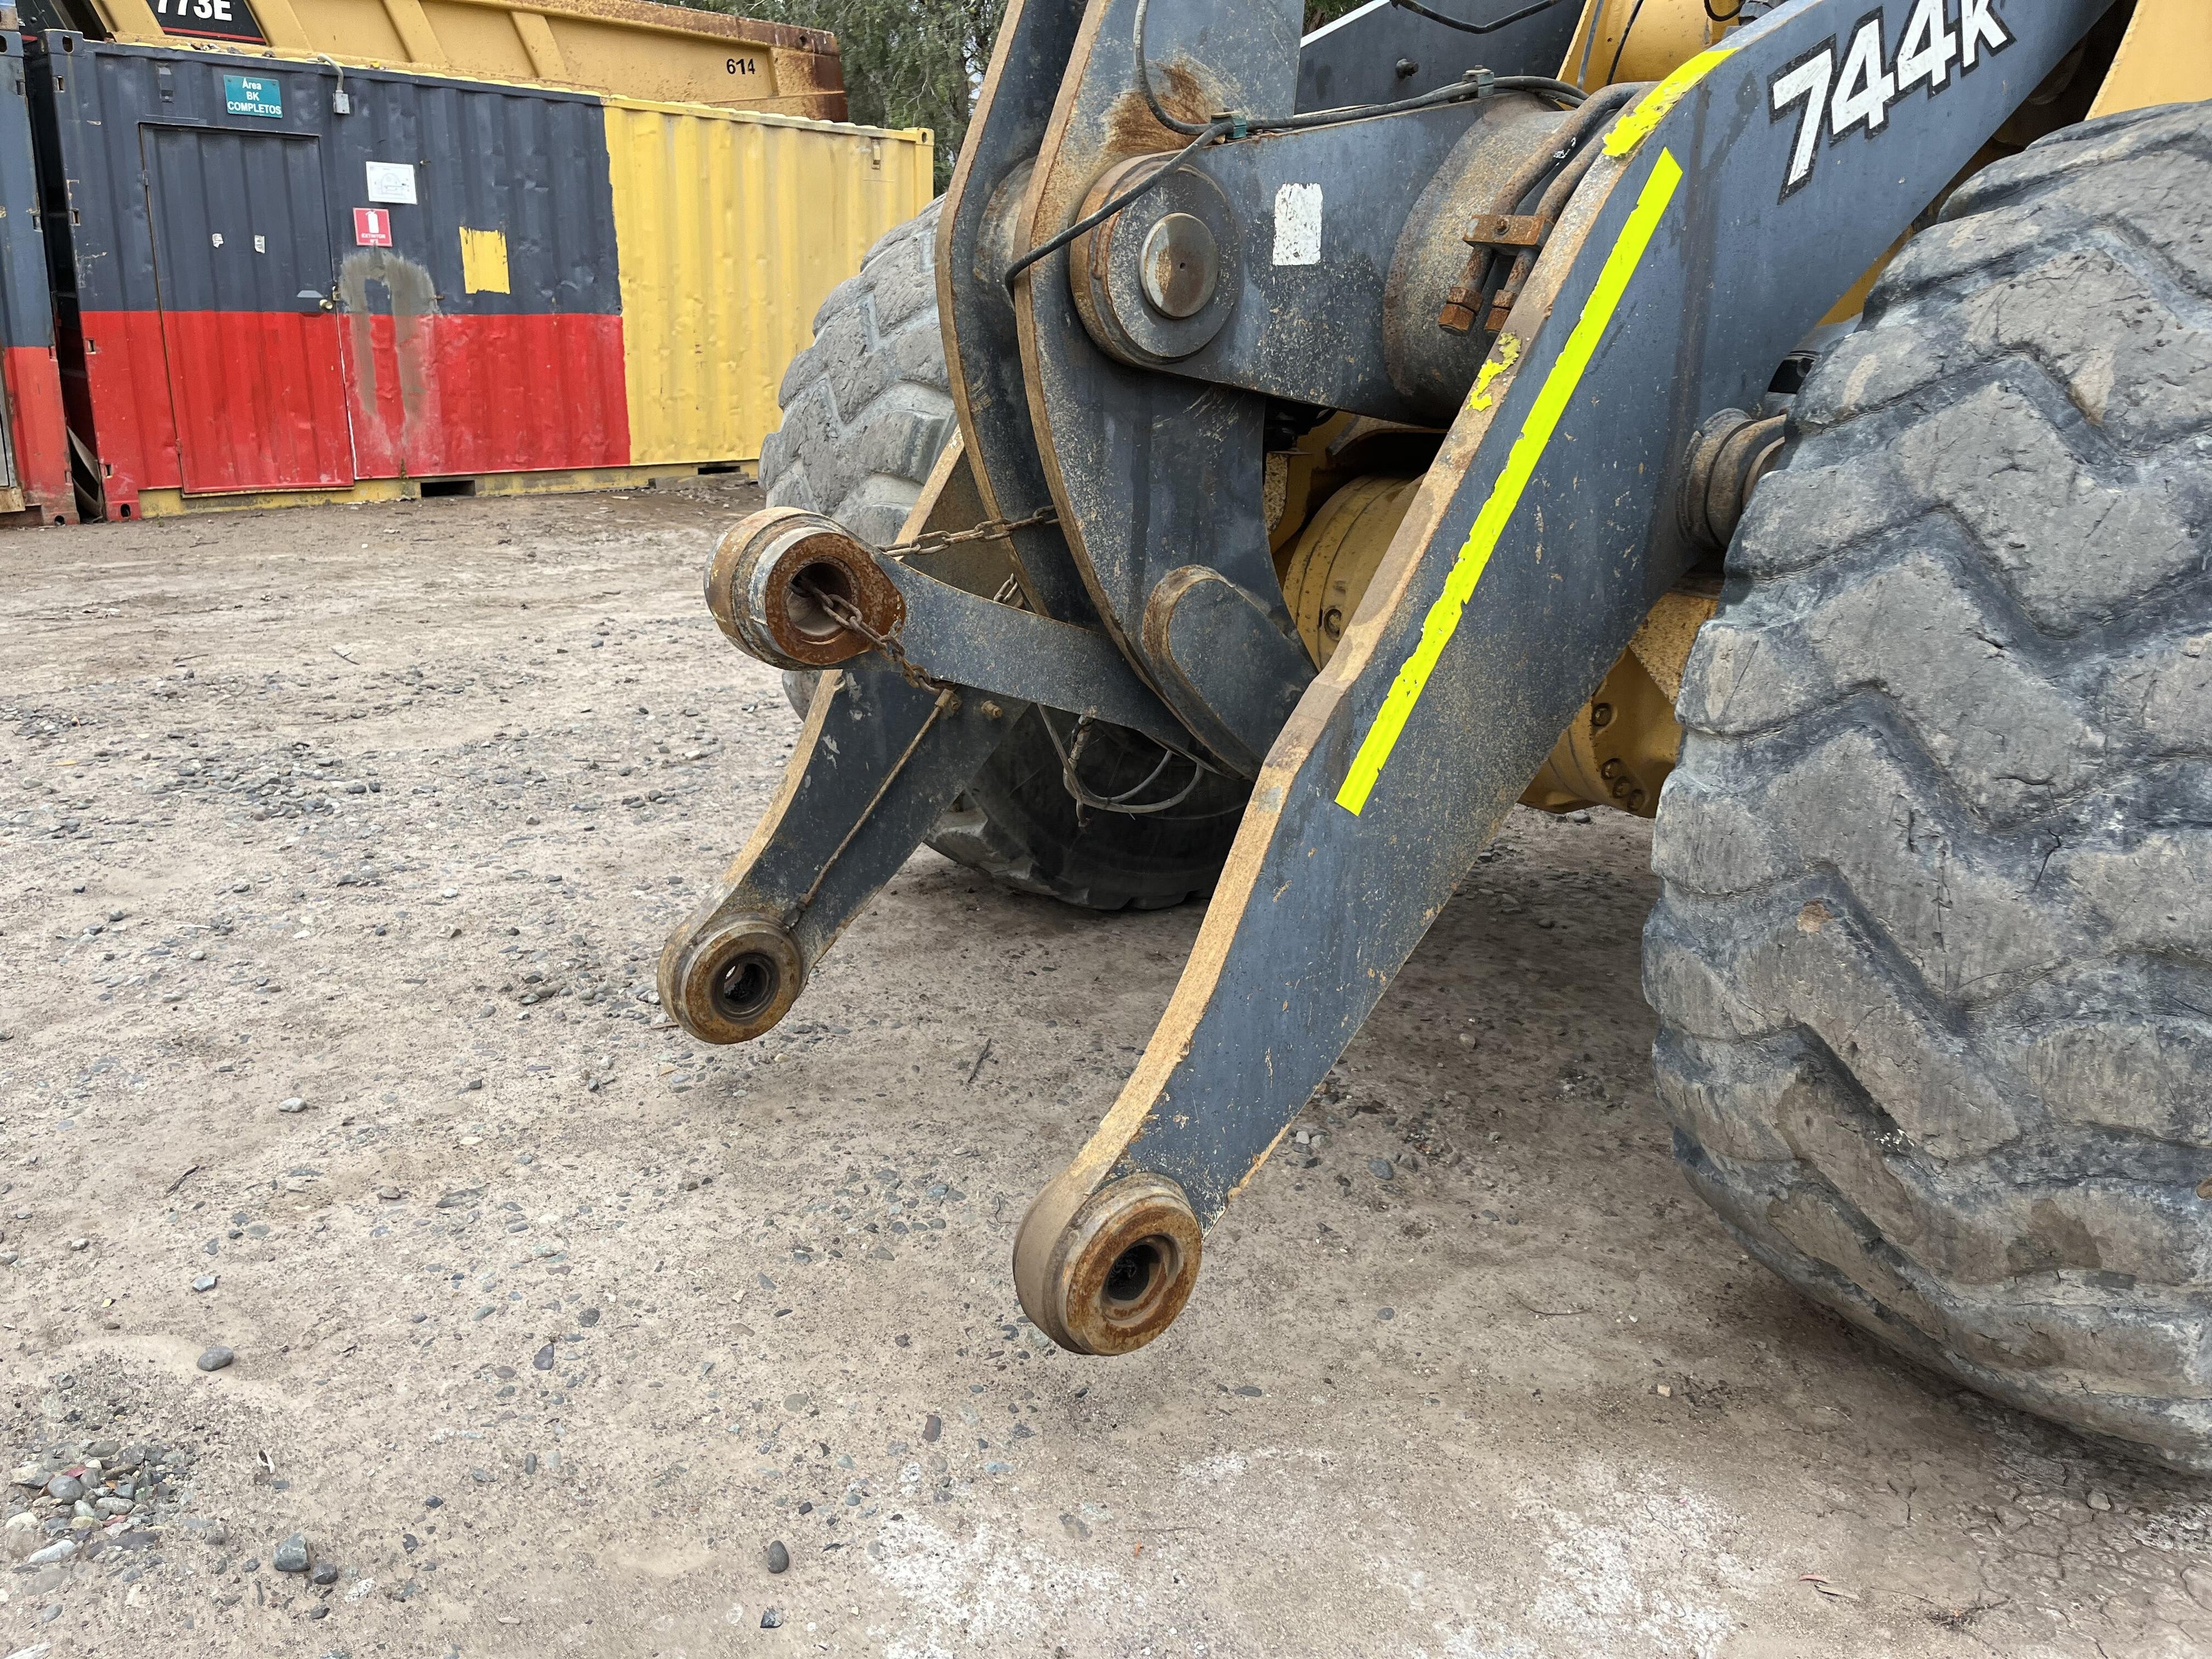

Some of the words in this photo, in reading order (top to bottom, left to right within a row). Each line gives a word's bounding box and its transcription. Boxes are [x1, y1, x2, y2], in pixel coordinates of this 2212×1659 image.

[726, 58, 755, 74] 614
[246, 91, 260, 101] BK
[227, 101, 282, 115] COMPLETOS
